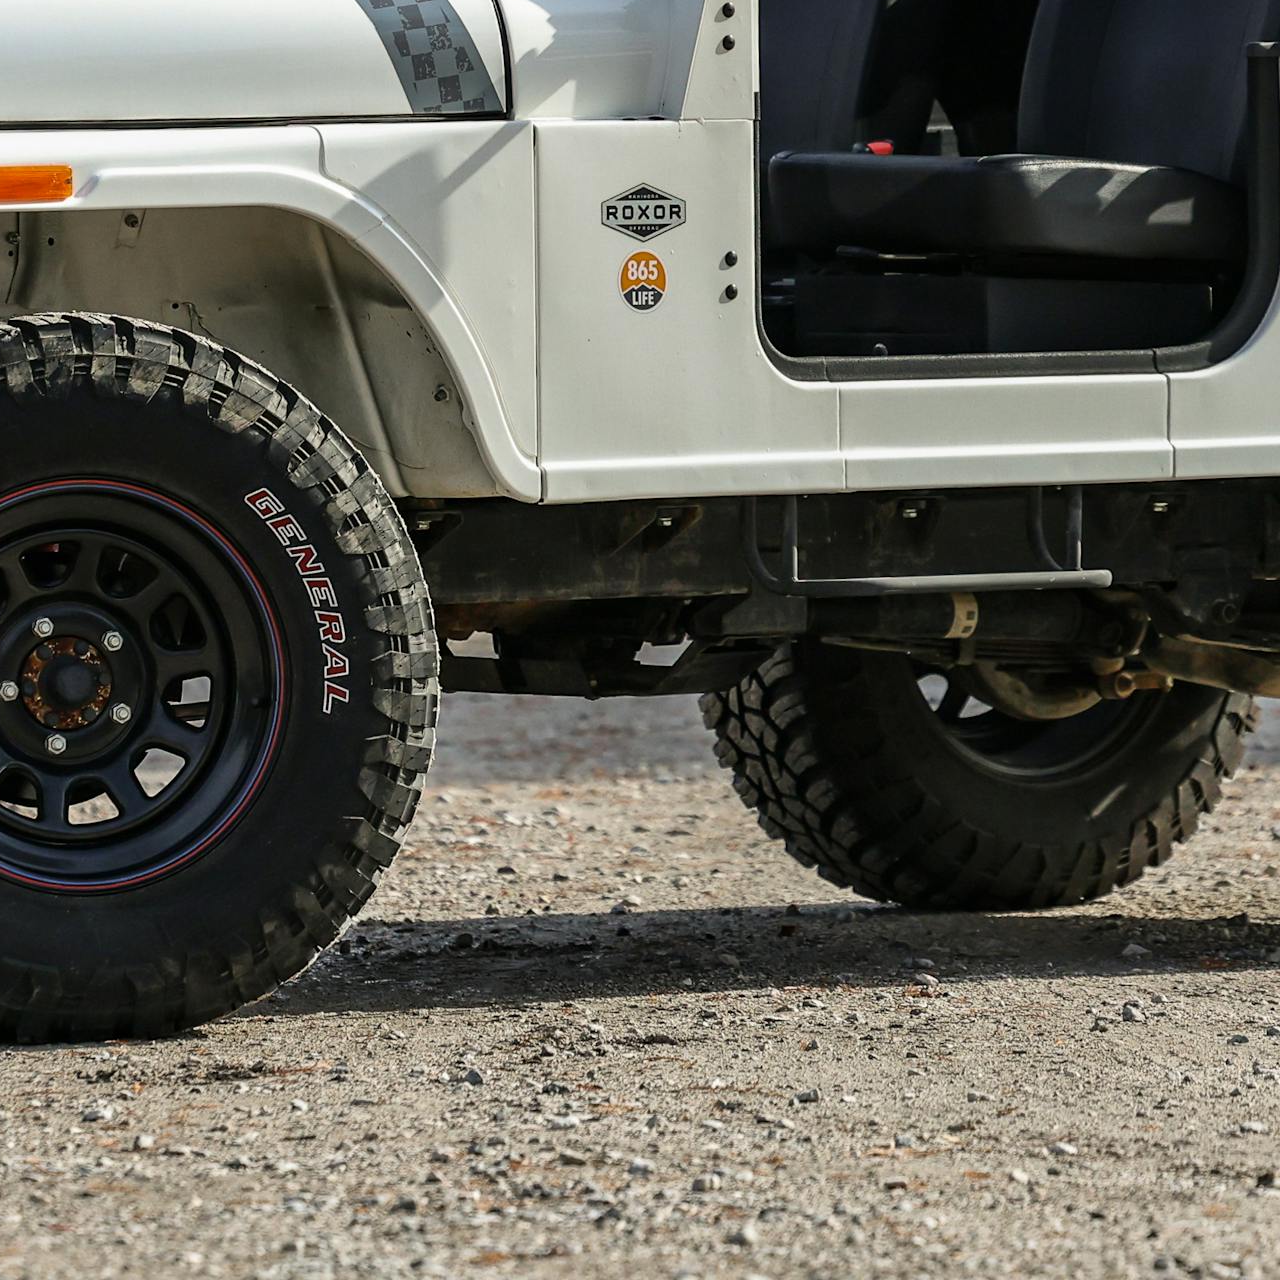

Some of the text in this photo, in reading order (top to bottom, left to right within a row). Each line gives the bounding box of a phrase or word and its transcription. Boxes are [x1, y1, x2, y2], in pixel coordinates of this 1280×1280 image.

[606, 204, 682, 220] ROXOR
[627, 260, 659, 280] 865
[632, 291, 655, 306] LIFE
[244, 487, 350, 714] GENERAL
